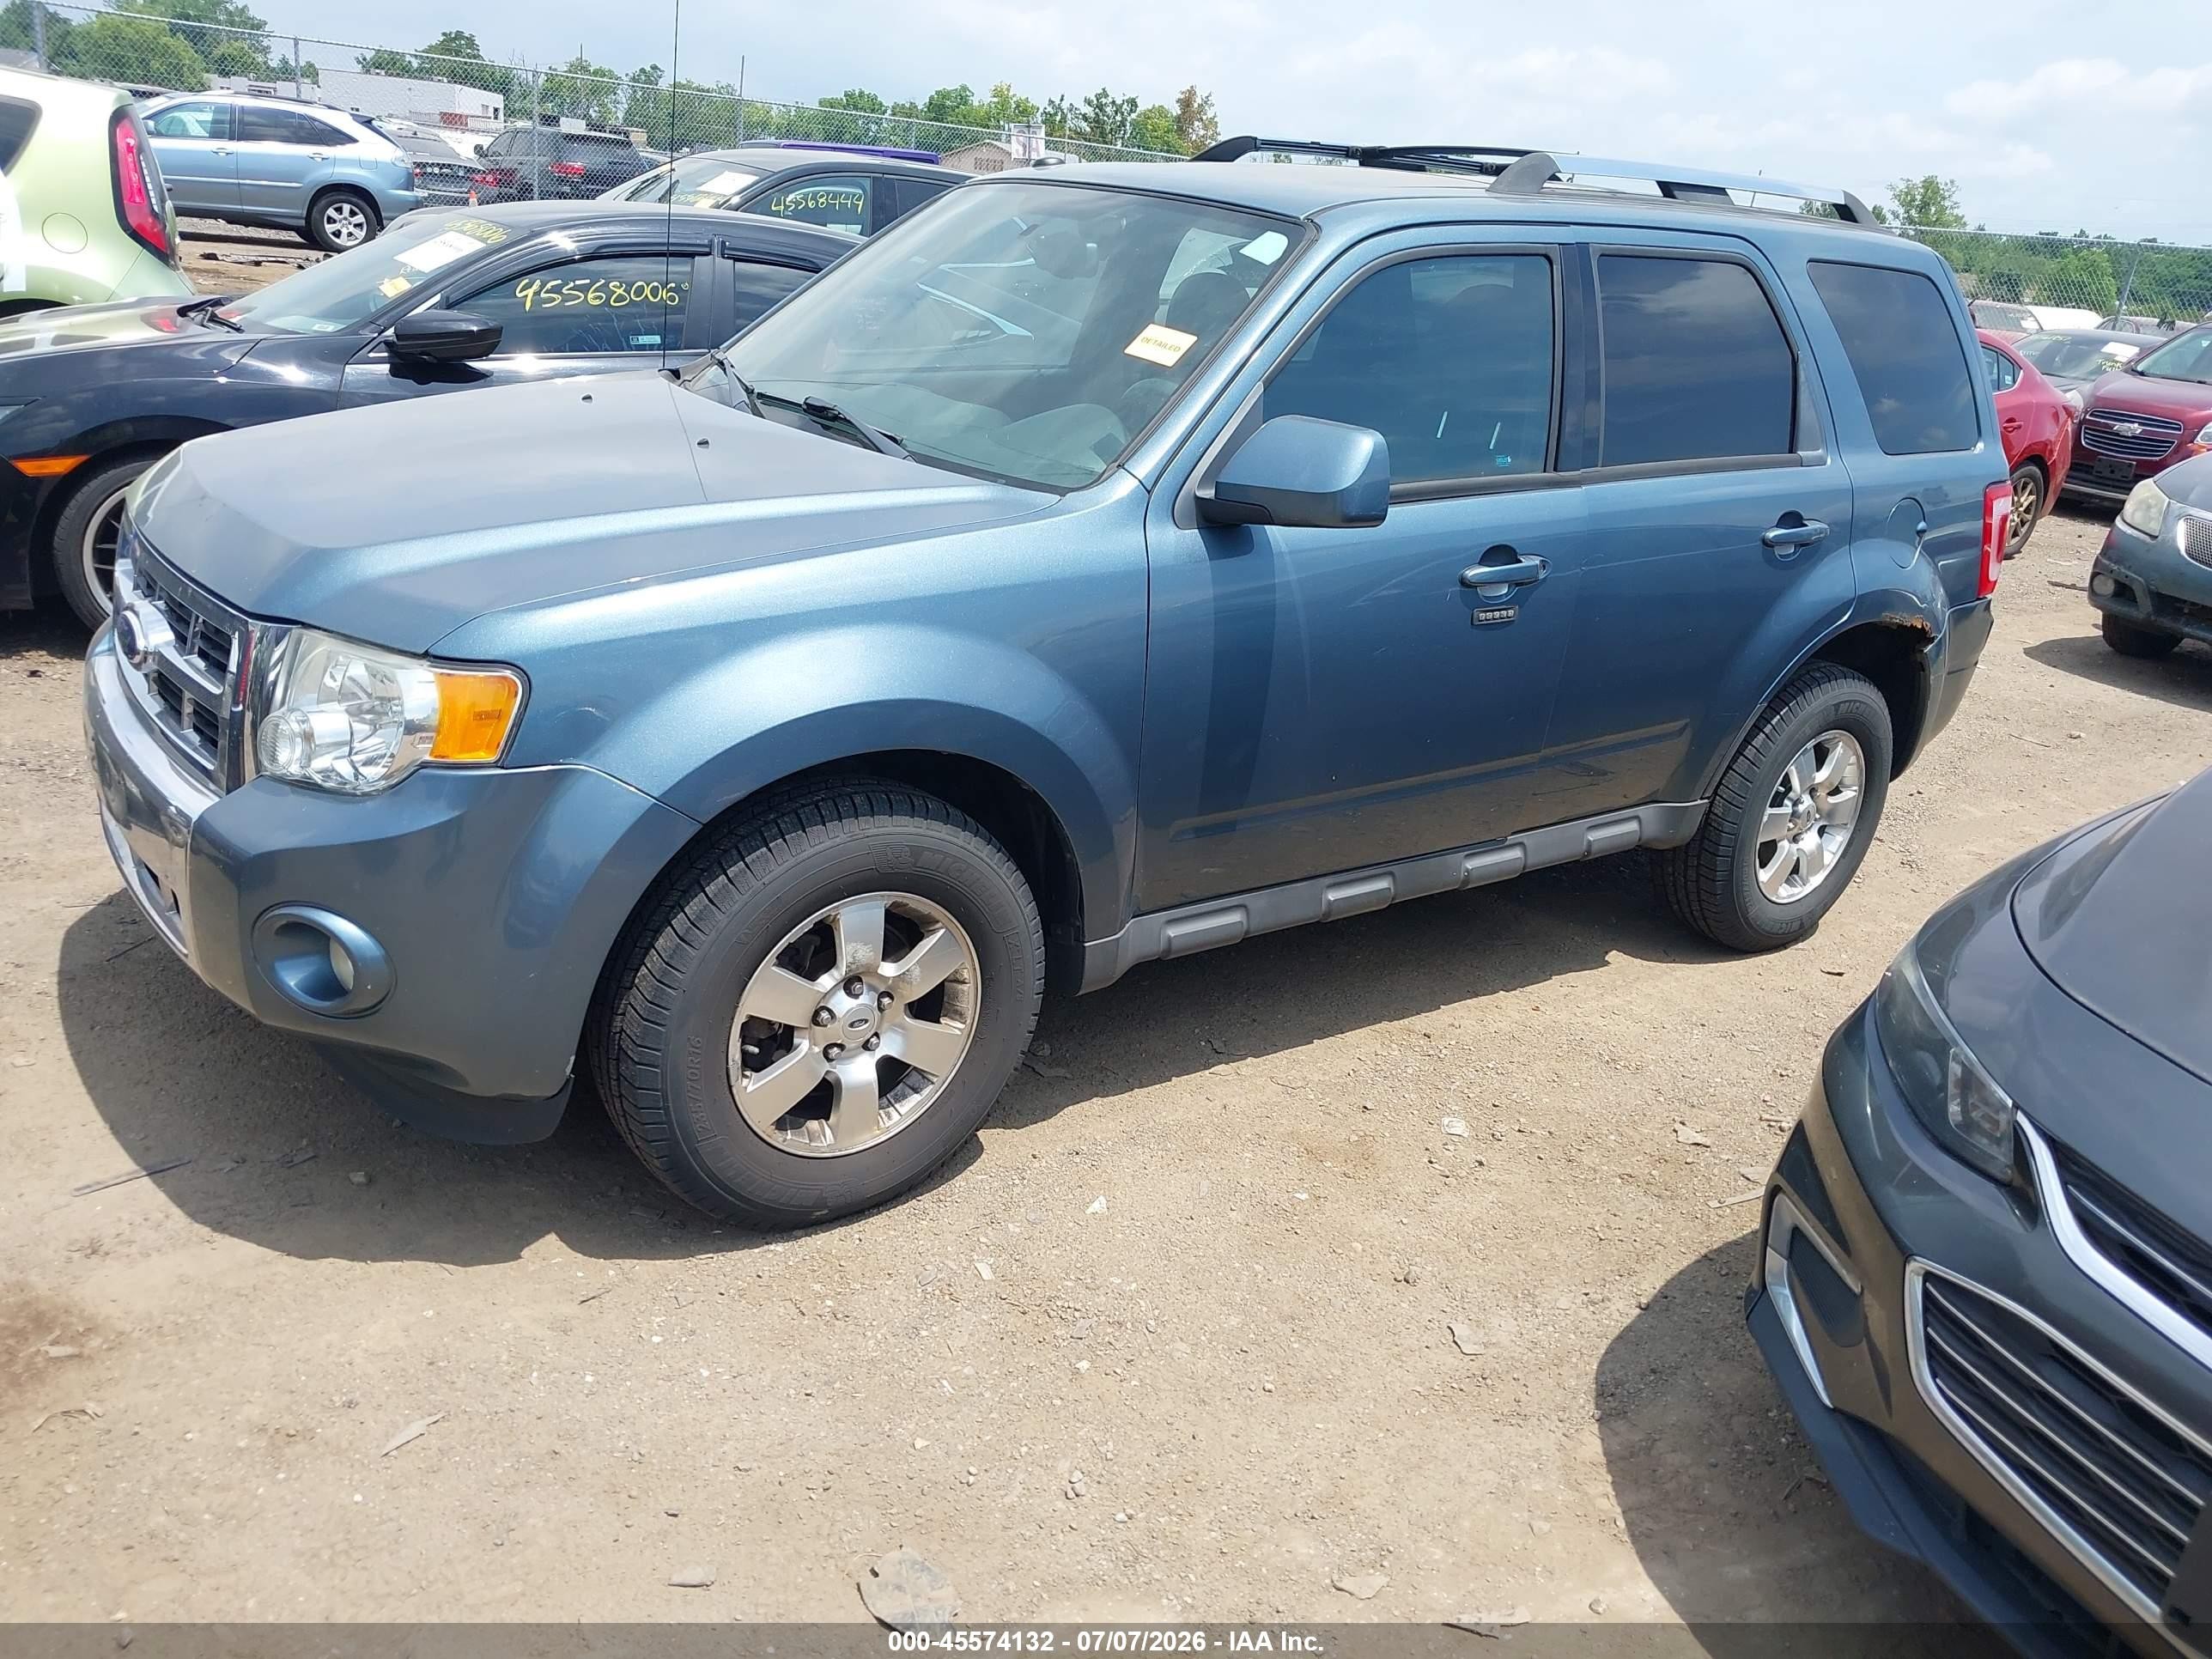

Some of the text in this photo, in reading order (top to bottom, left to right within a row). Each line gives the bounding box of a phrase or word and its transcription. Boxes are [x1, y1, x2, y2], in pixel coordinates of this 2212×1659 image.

[771, 191, 865, 216] 45568444
[515, 278, 680, 313] 45568006
[1141, 337, 1182, 353] DETAILED
